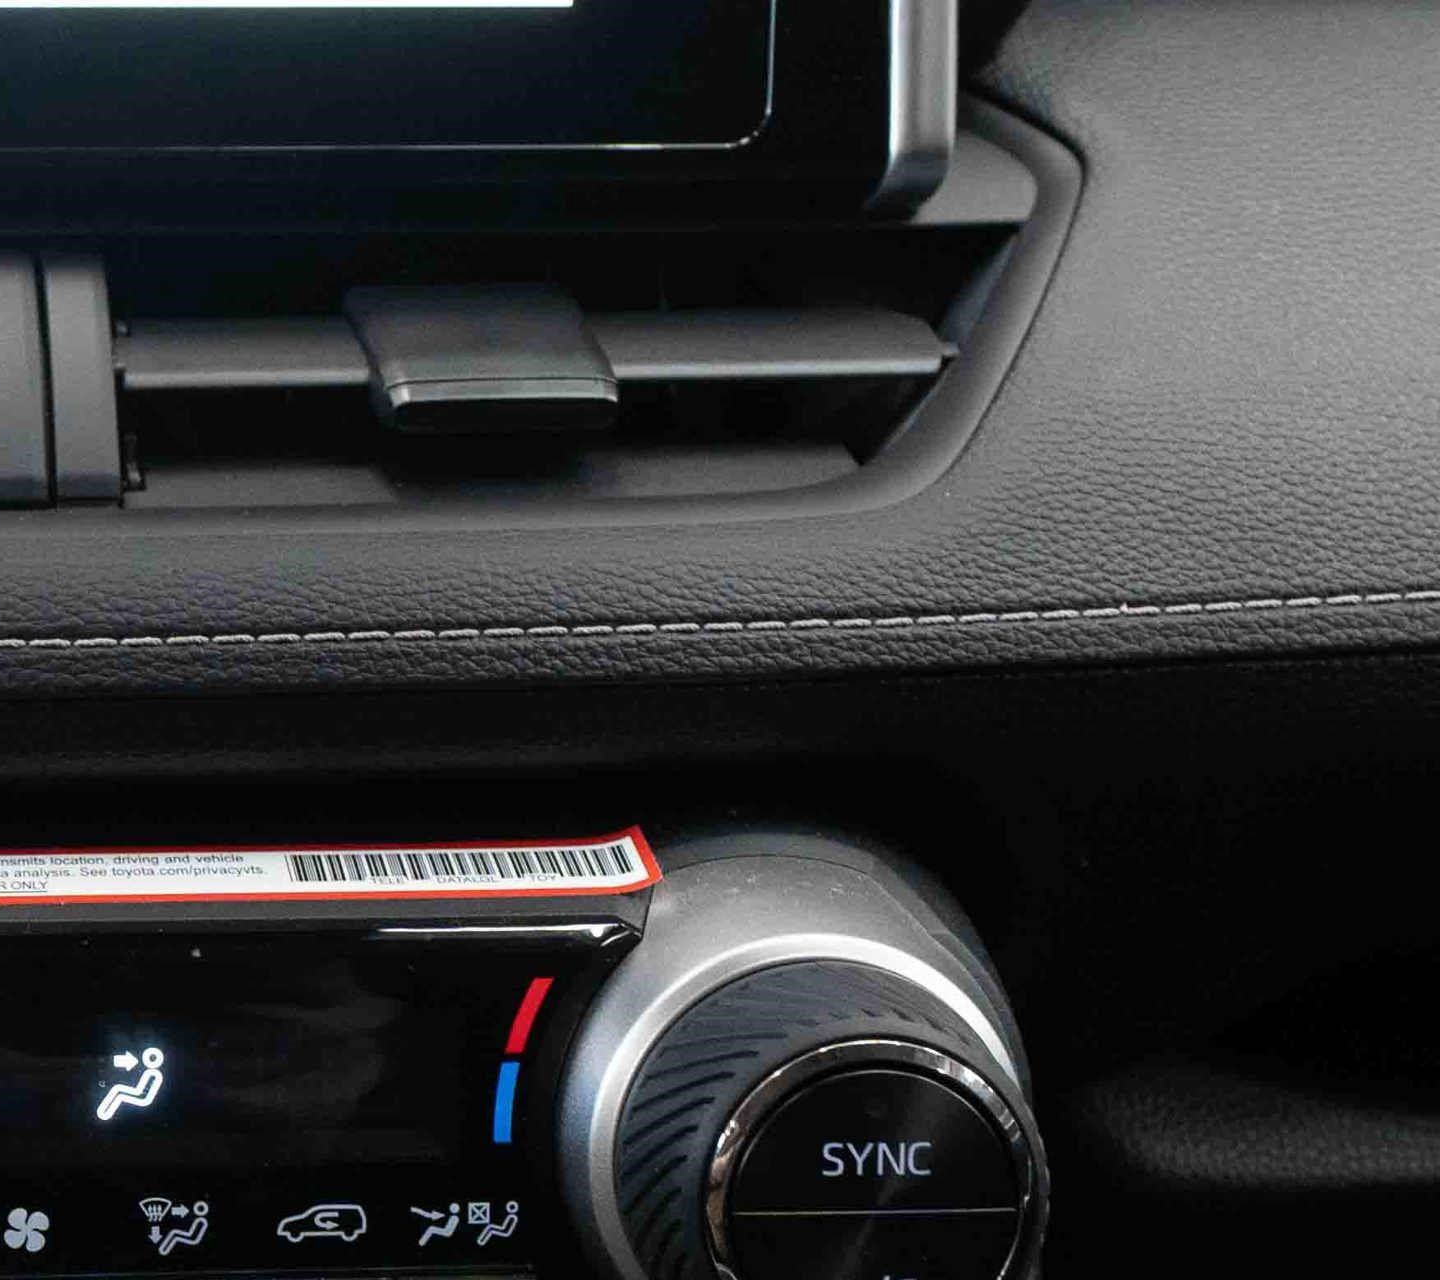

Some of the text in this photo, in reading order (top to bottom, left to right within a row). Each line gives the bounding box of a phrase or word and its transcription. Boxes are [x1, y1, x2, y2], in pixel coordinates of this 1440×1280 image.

[113, 855, 159, 865] driving
[164, 855, 190, 864] and
[195, 854, 244, 864] vehicle
[79, 867, 108, 877] See
[10, 880, 48, 890] ONLY
[822, 1142, 932, 1176] SYNC
